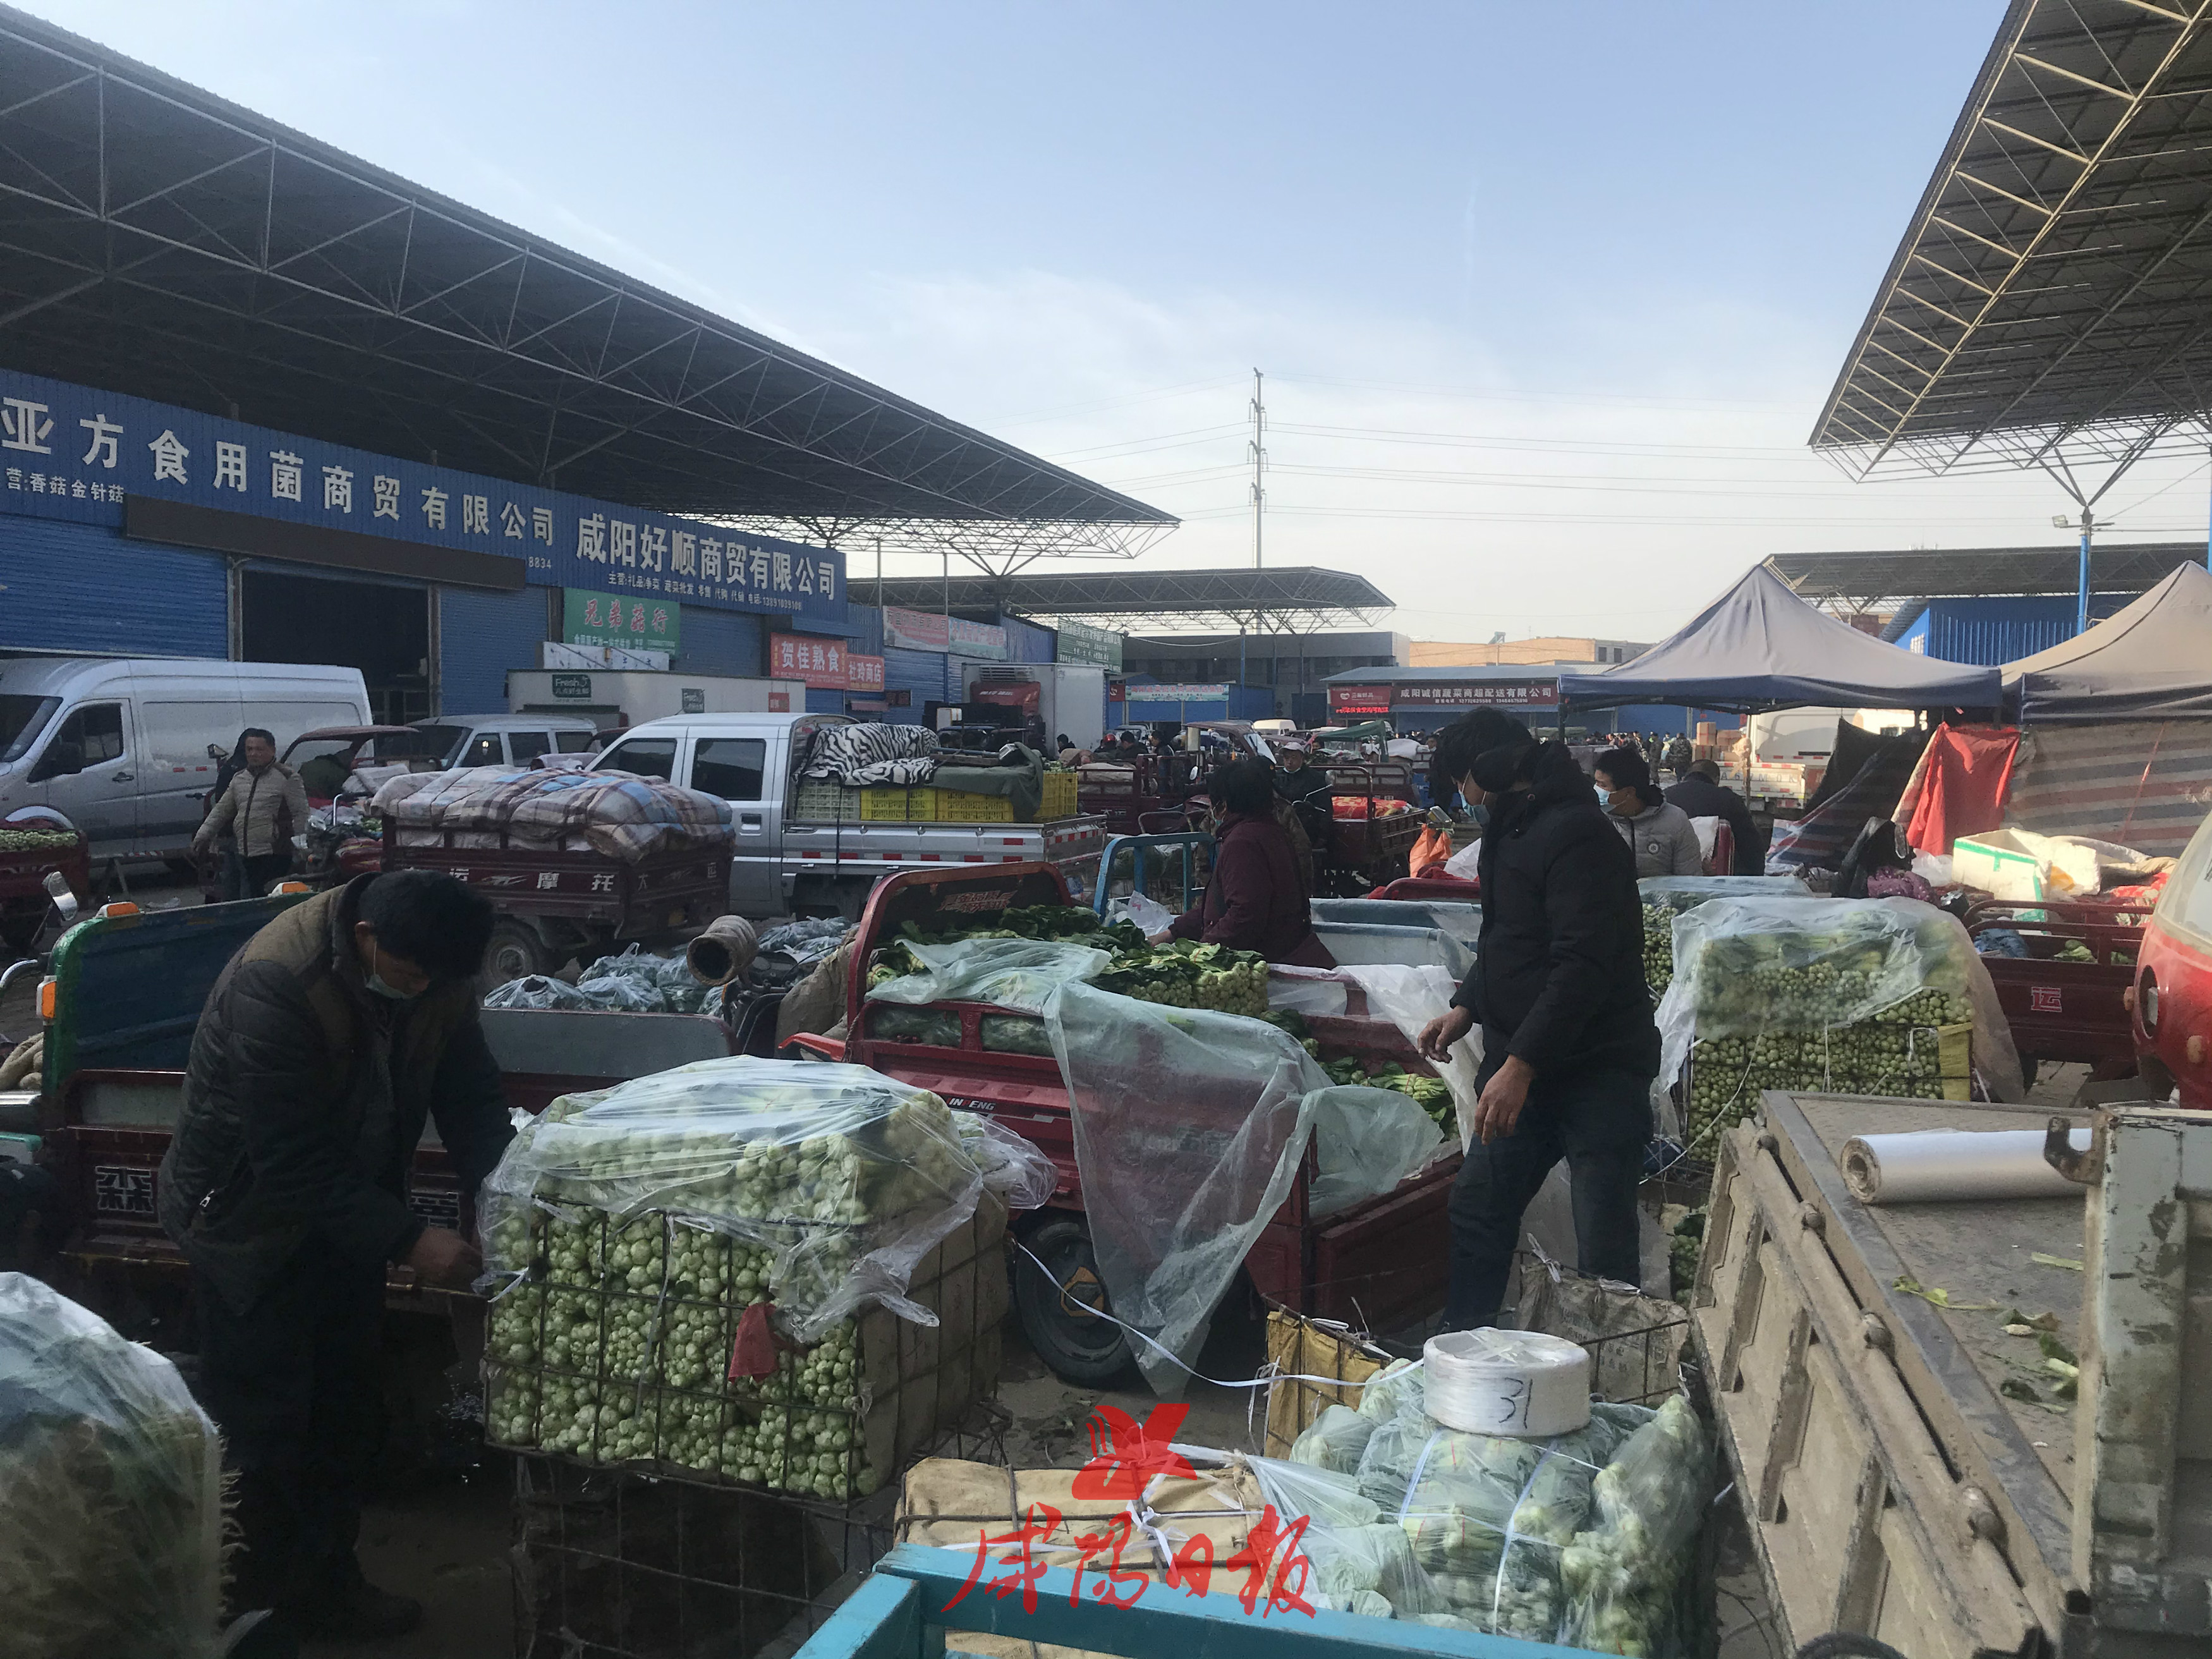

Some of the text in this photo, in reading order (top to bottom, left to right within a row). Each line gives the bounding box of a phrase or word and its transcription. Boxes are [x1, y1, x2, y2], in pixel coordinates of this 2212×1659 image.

[1, 397, 554, 547] 亚方食用菌商贸有限公司
[576, 513, 836, 601] 咸阳好顺商贸有限公司
[781, 641, 839, 672] 贺佳熟食
[1401, 688, 1552, 698] 咸阳诚信蔬菜商超配送有限公司
[537, 872, 614, 892] 摩托
